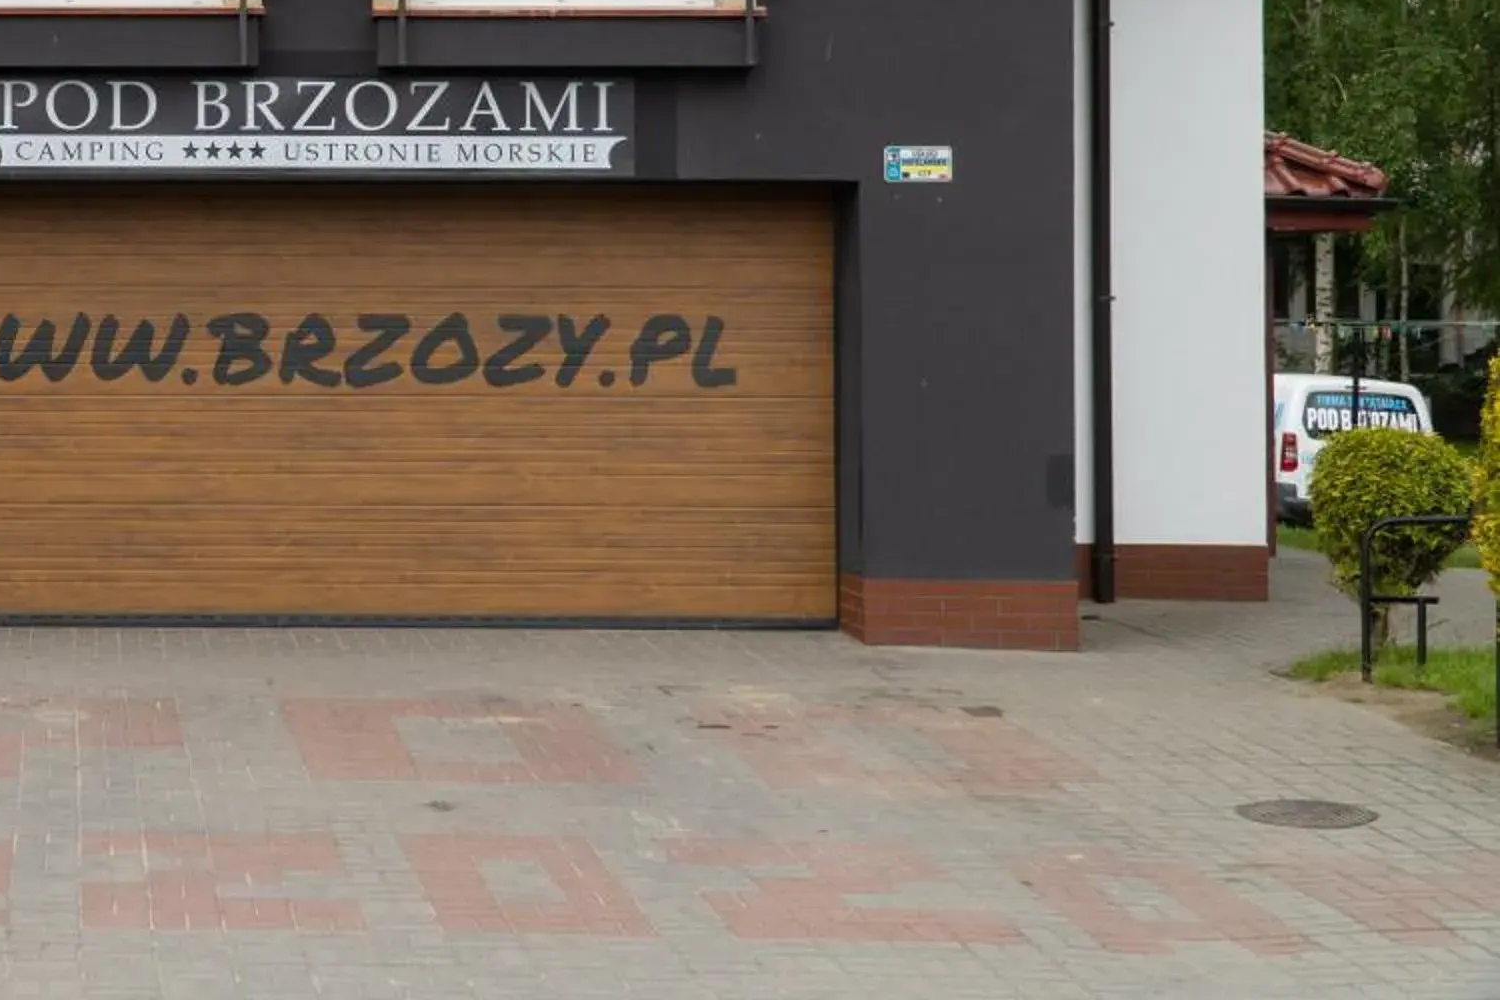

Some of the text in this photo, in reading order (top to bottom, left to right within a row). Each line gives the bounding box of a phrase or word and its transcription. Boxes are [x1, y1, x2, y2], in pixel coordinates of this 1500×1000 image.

[192, 81, 612, 131] BRZOZAMI
[15, 142, 597, 162] CAMPING USTRONIE MORSKIE
[1307, 407, 1338, 430] POD
